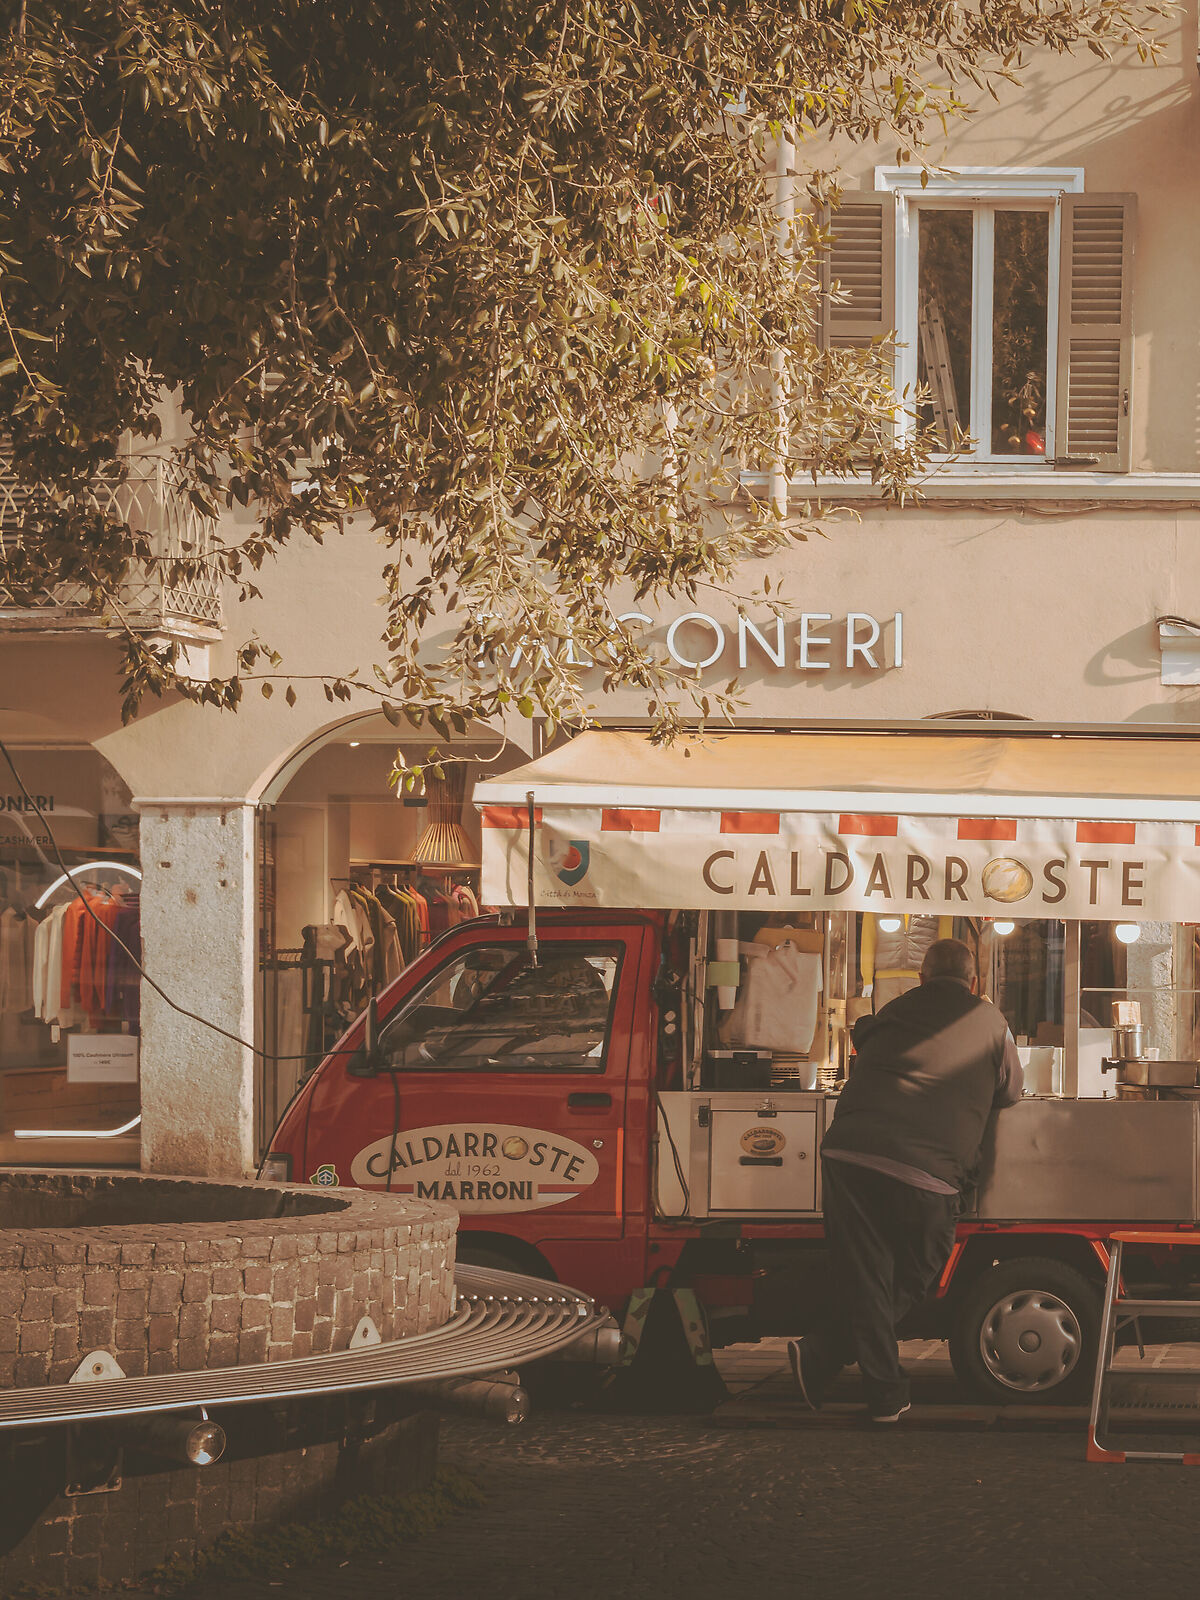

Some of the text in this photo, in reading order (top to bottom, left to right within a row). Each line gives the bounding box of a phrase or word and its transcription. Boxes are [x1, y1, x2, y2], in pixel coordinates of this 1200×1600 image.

[443, 1162, 499, 1177] dal 1962
[417, 1180, 531, 1200] MARRONI
